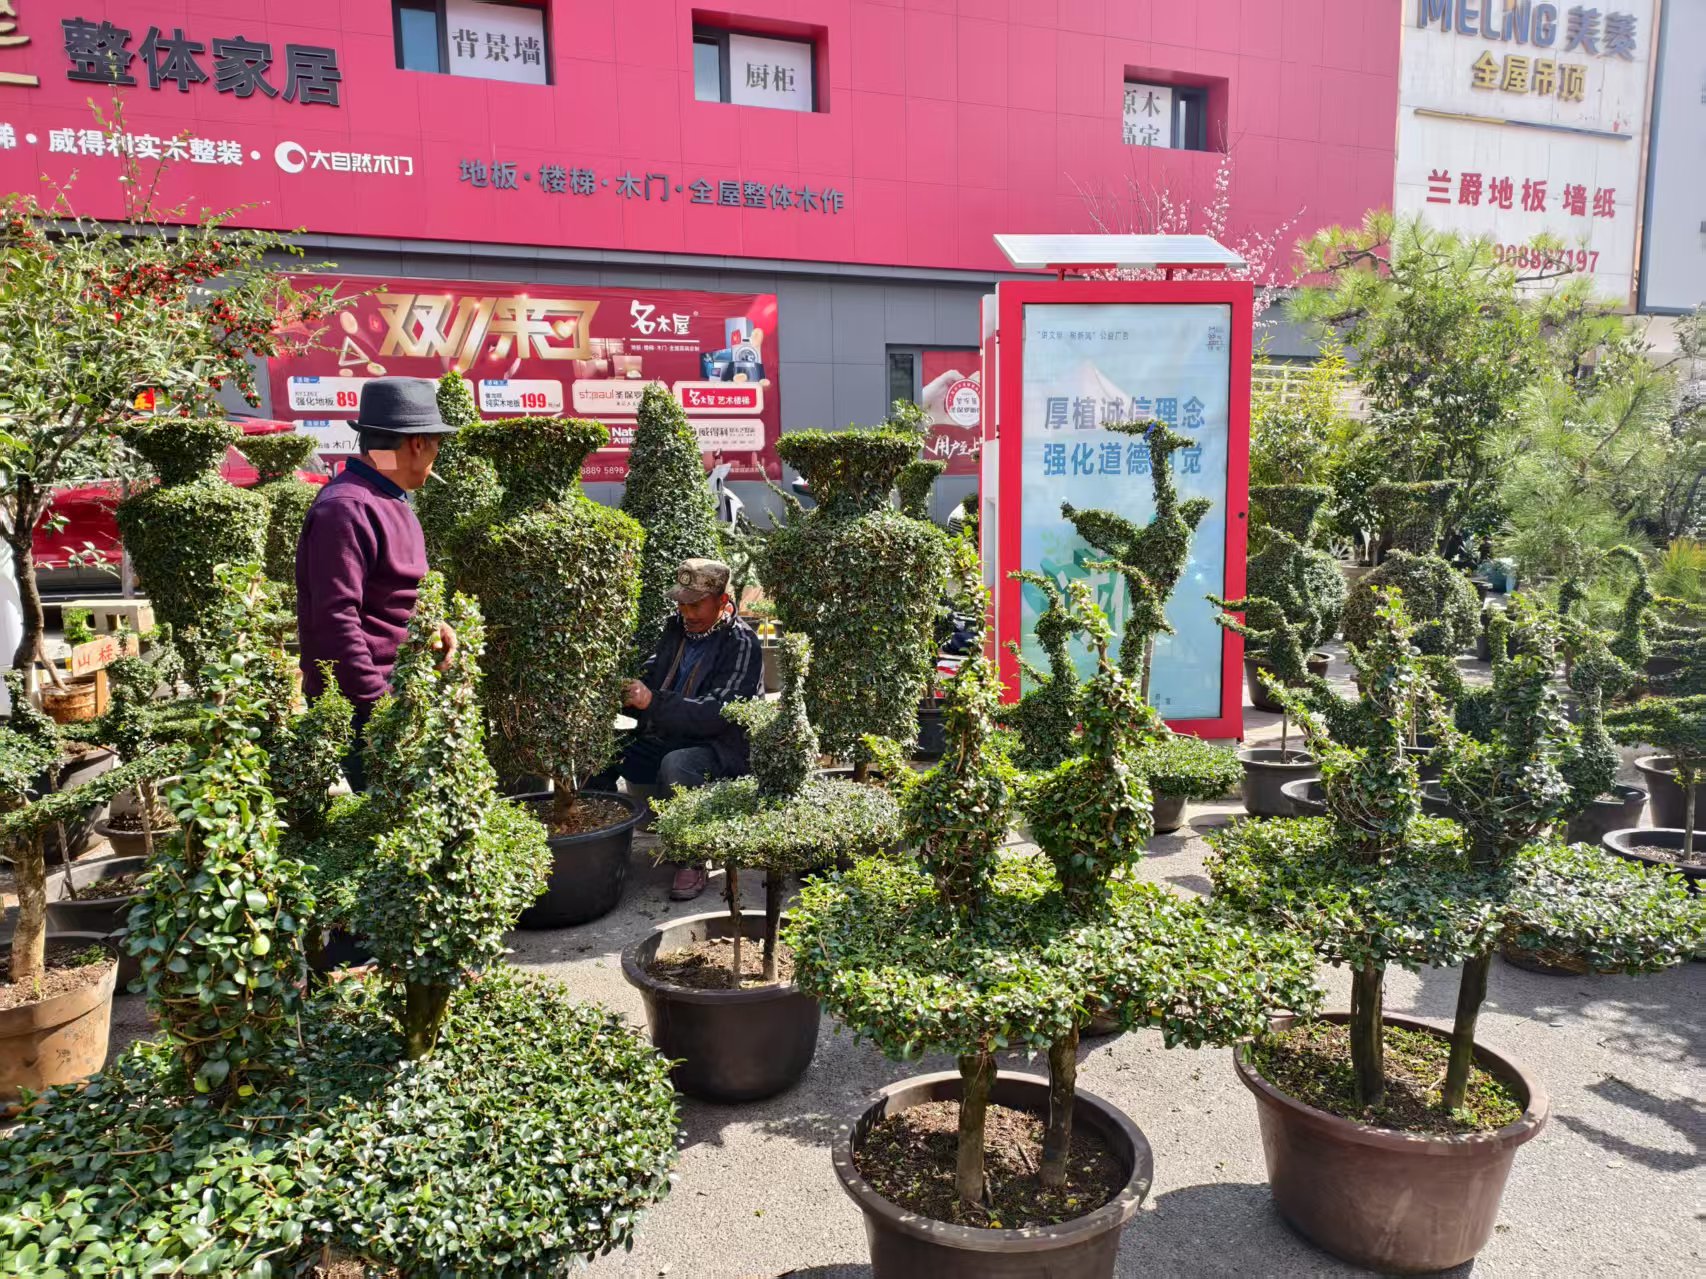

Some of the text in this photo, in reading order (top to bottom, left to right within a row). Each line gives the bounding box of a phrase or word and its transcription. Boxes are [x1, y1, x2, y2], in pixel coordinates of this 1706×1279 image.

[61, 17, 343, 106] 整体家居
[451, 29, 542, 66] 背景墙
[745, 62, 796, 93] 厨柜
[1471, 50, 1588, 102] 全屋吊顶
[309, 149, 413, 176] 大自然木门
[1562, 183, 1616, 219] 墙纸
[630, 300, 690, 335] 名木屋
[336, 391, 358, 408] 89
[520, 393, 547, 408] 199
[1045, 396, 1205, 430] 厚植诚信理念
[1043, 442, 1203, 476] 强化道德觉
